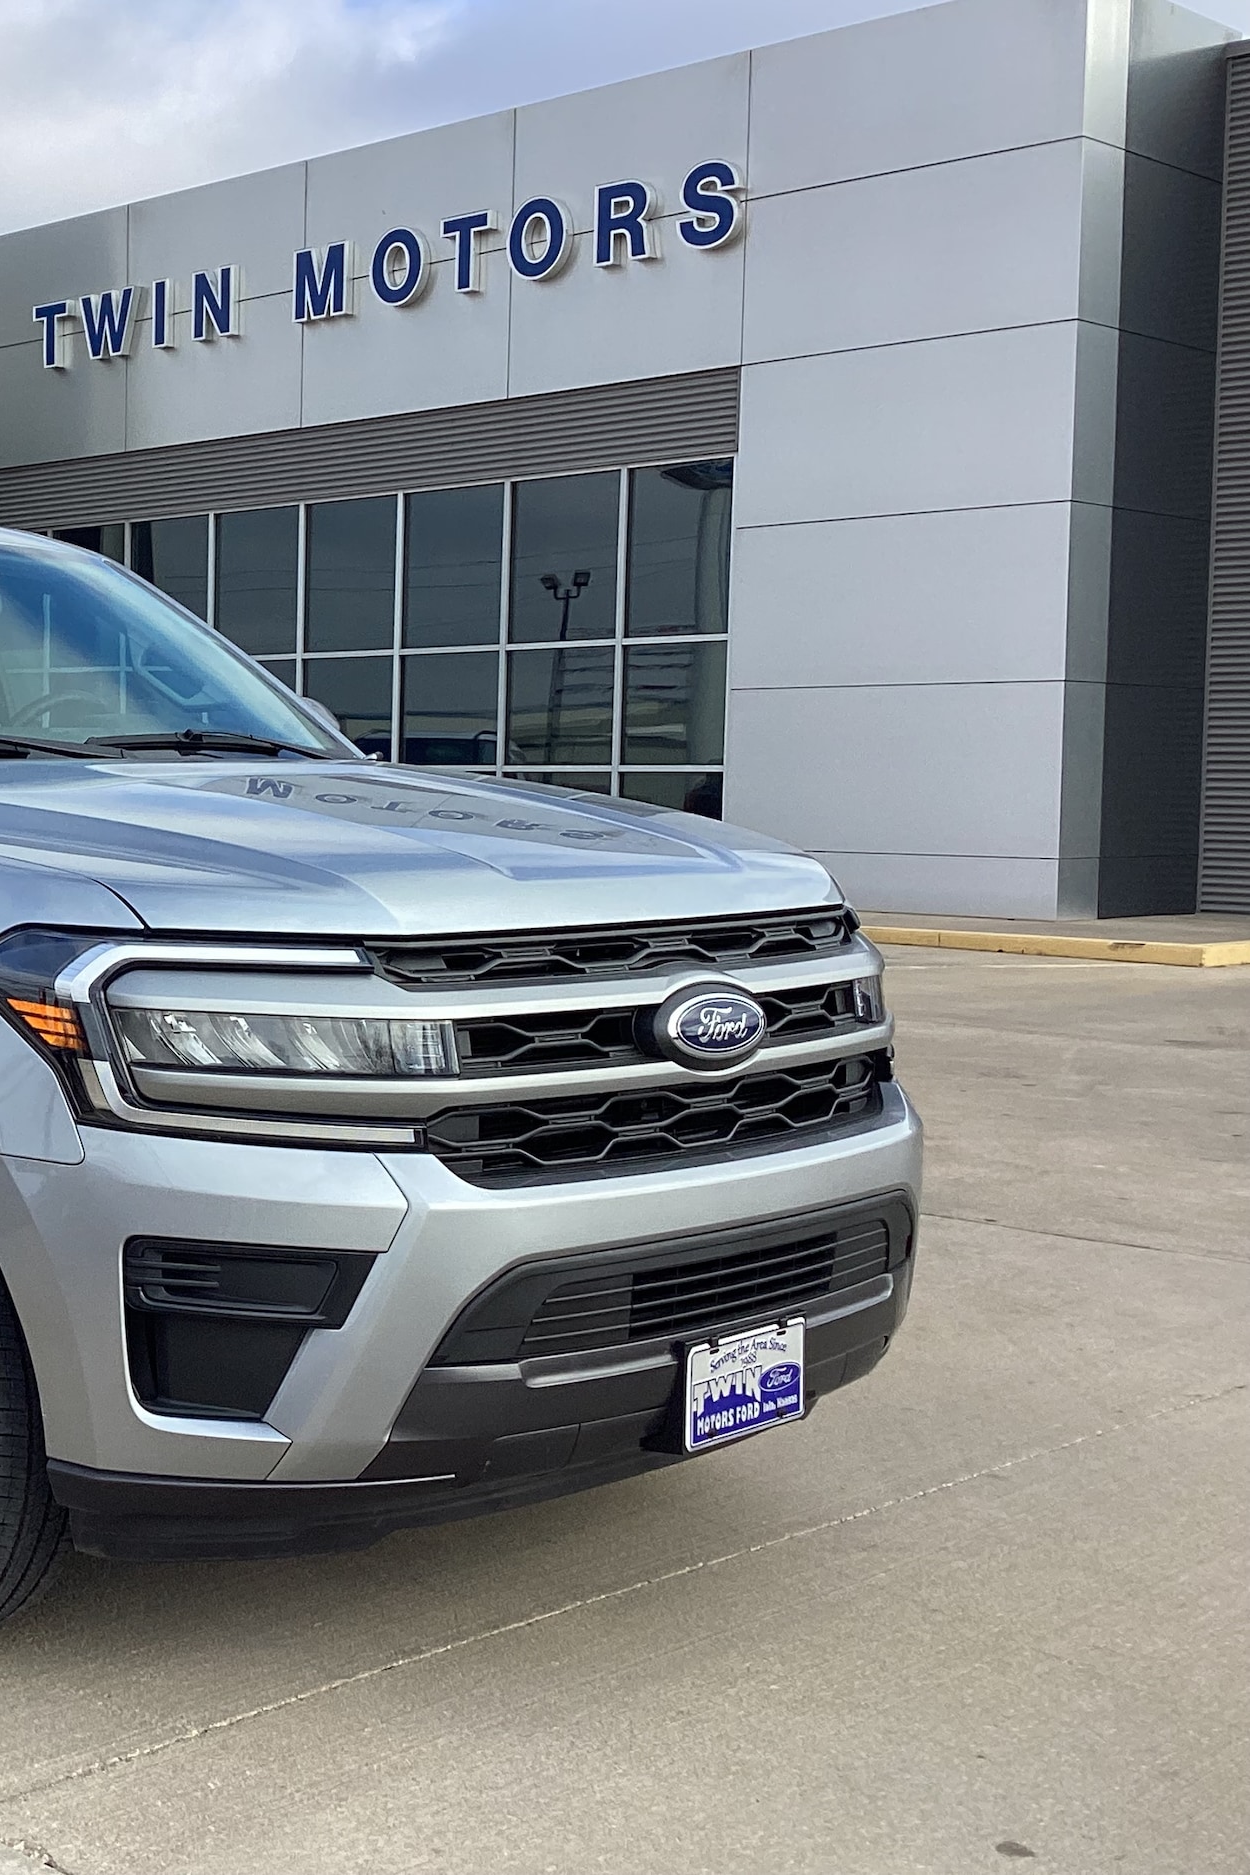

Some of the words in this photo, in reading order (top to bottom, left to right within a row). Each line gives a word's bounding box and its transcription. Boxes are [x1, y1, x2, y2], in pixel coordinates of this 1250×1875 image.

[32, 264, 240, 369] TWIN
[292, 158, 743, 324] MOTORS
[697, 1006, 748, 1043] Ford
[710, 1348, 737, 1373] Serving
[737, 1340, 750, 1355] the
[750, 1338, 768, 1351] Area
[769, 1337, 788, 1352] Since
[693, 1364, 762, 1417] TWIN
[767, 1367, 793, 1388] Ford
[697, 1407, 735, 1436] MOTORS
[736, 1401, 761, 1424] FORD
